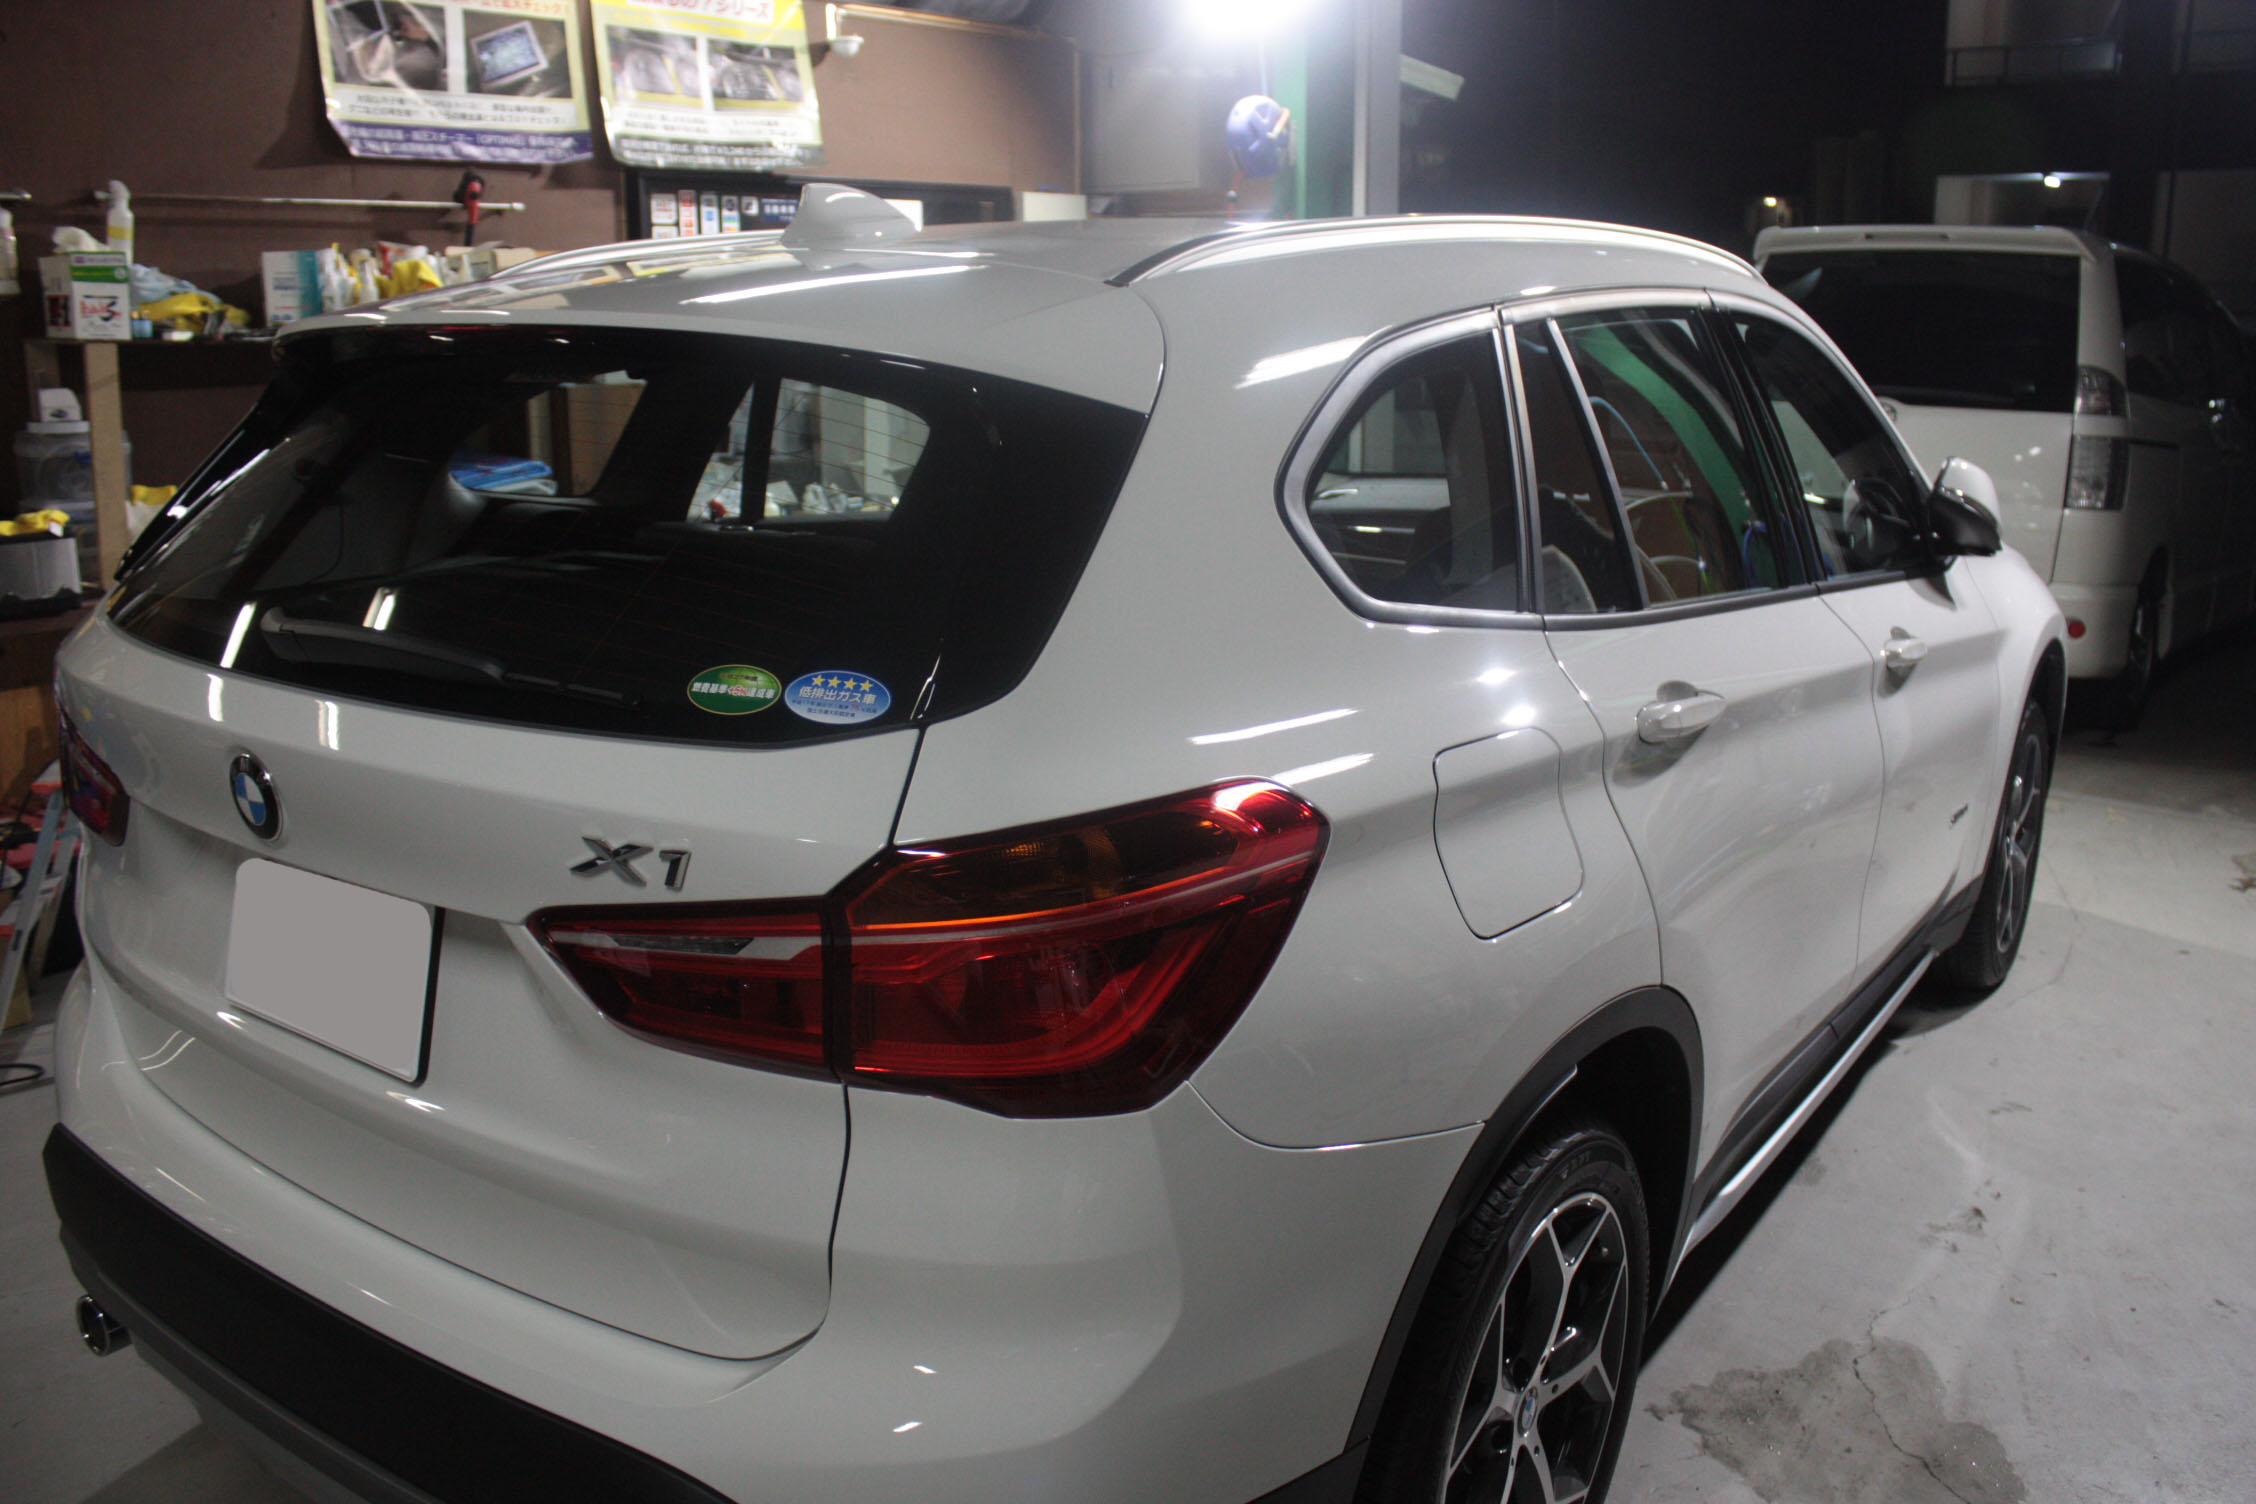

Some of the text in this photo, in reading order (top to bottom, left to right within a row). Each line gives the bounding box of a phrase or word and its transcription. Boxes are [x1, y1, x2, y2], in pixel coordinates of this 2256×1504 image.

[799, 686, 877, 705] 低排出ガス車
[570, 835, 692, 892] X1
